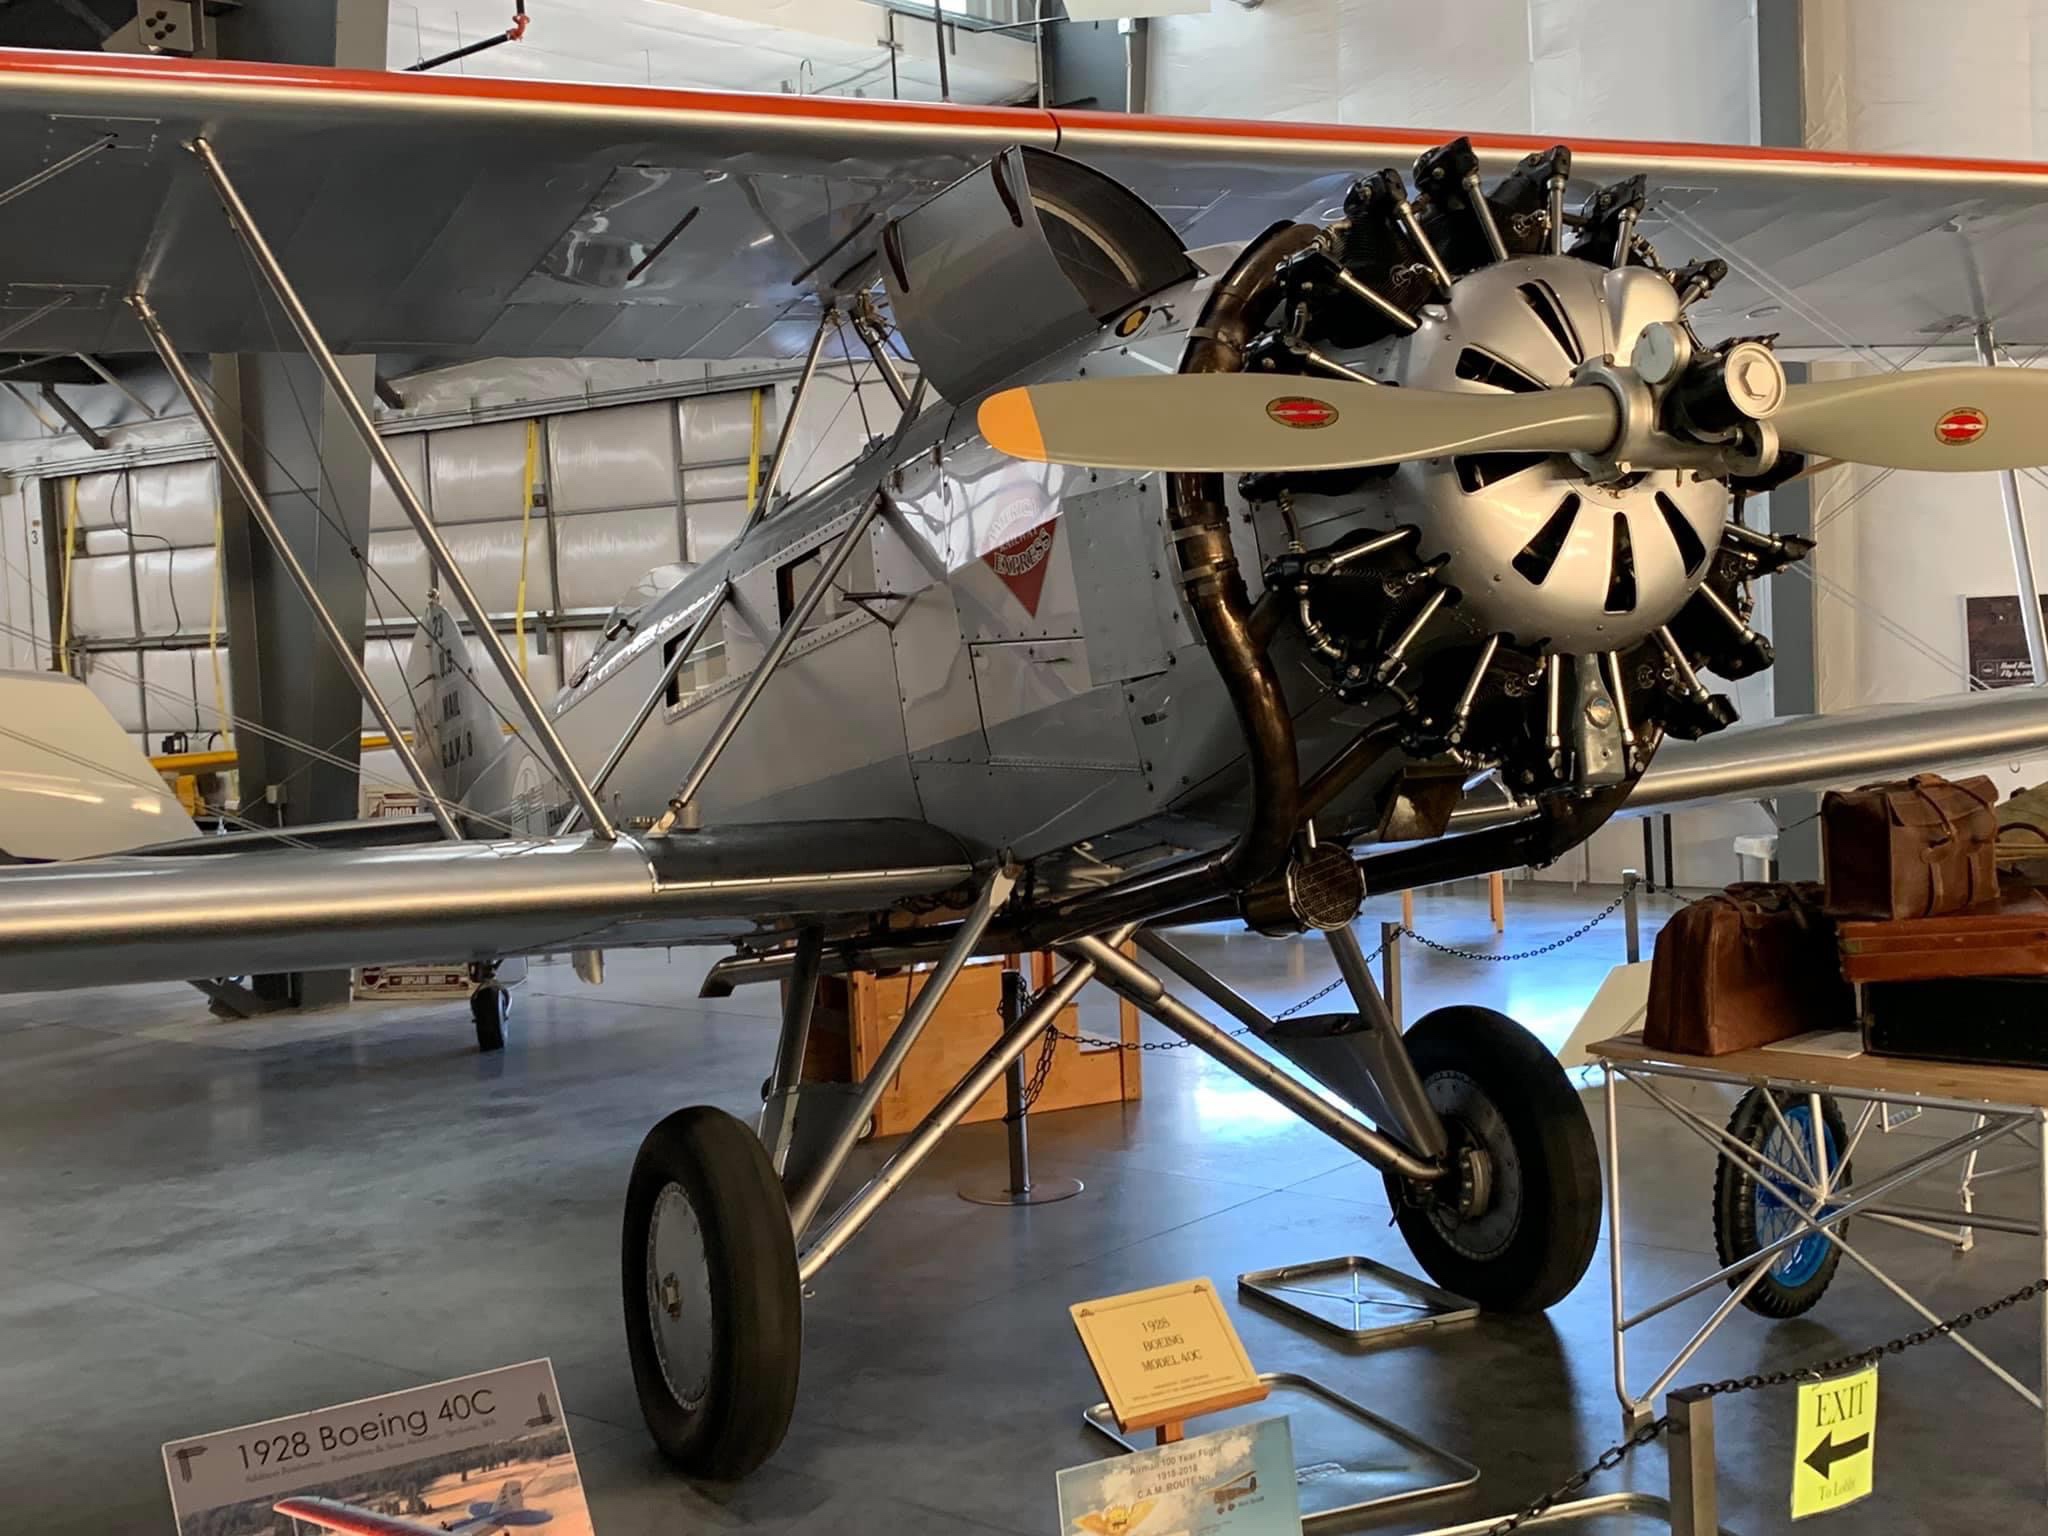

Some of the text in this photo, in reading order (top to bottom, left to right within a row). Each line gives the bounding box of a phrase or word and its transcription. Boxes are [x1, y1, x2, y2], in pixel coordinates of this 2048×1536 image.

[32, 530, 39, 544] 3
[993, 528, 1050, 576] EXPRESS
[1141, 1317, 1170, 1333] 1928
[1142, 1335, 1184, 1352] BOEING
[1141, 1354, 1180, 1372] MODEL
[1816, 1380, 1869, 1427] EXIT
[238, 1431, 310, 1469] 1928
[319, 1411, 428, 1452] Boeing
[438, 1389, 496, 1422] 40C
[1819, 1486, 1831, 1501] To
